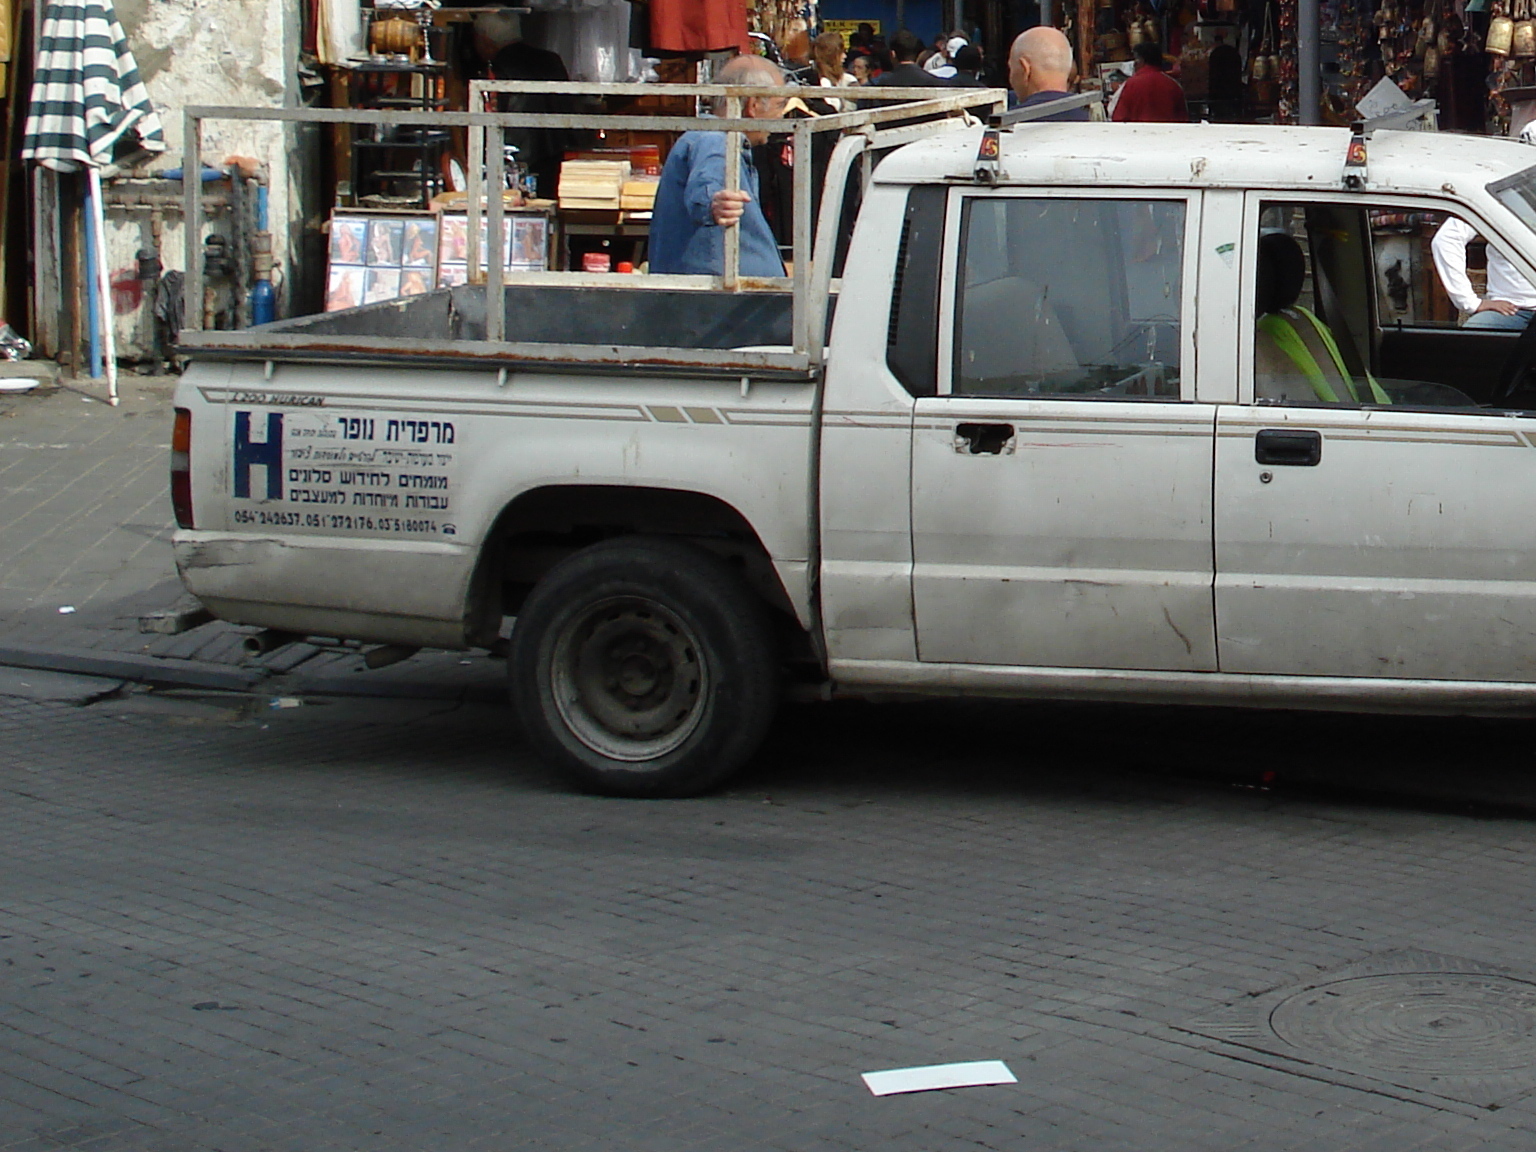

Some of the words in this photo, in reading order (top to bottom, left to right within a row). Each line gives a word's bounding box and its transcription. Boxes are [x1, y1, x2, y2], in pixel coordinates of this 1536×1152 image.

[338, 417, 375, 440] נופר
[386, 419, 455, 444] מרפדית
[233, 411, 284, 500] H
[288, 468, 332, 484] סלונים
[339, 471, 391, 487] לחידוש
[398, 474, 449, 490] מומחים
[290, 488, 346, 505] למעצבים
[352, 491, 399, 508] מיוחדות
[405, 494, 449, 510] עבודות
